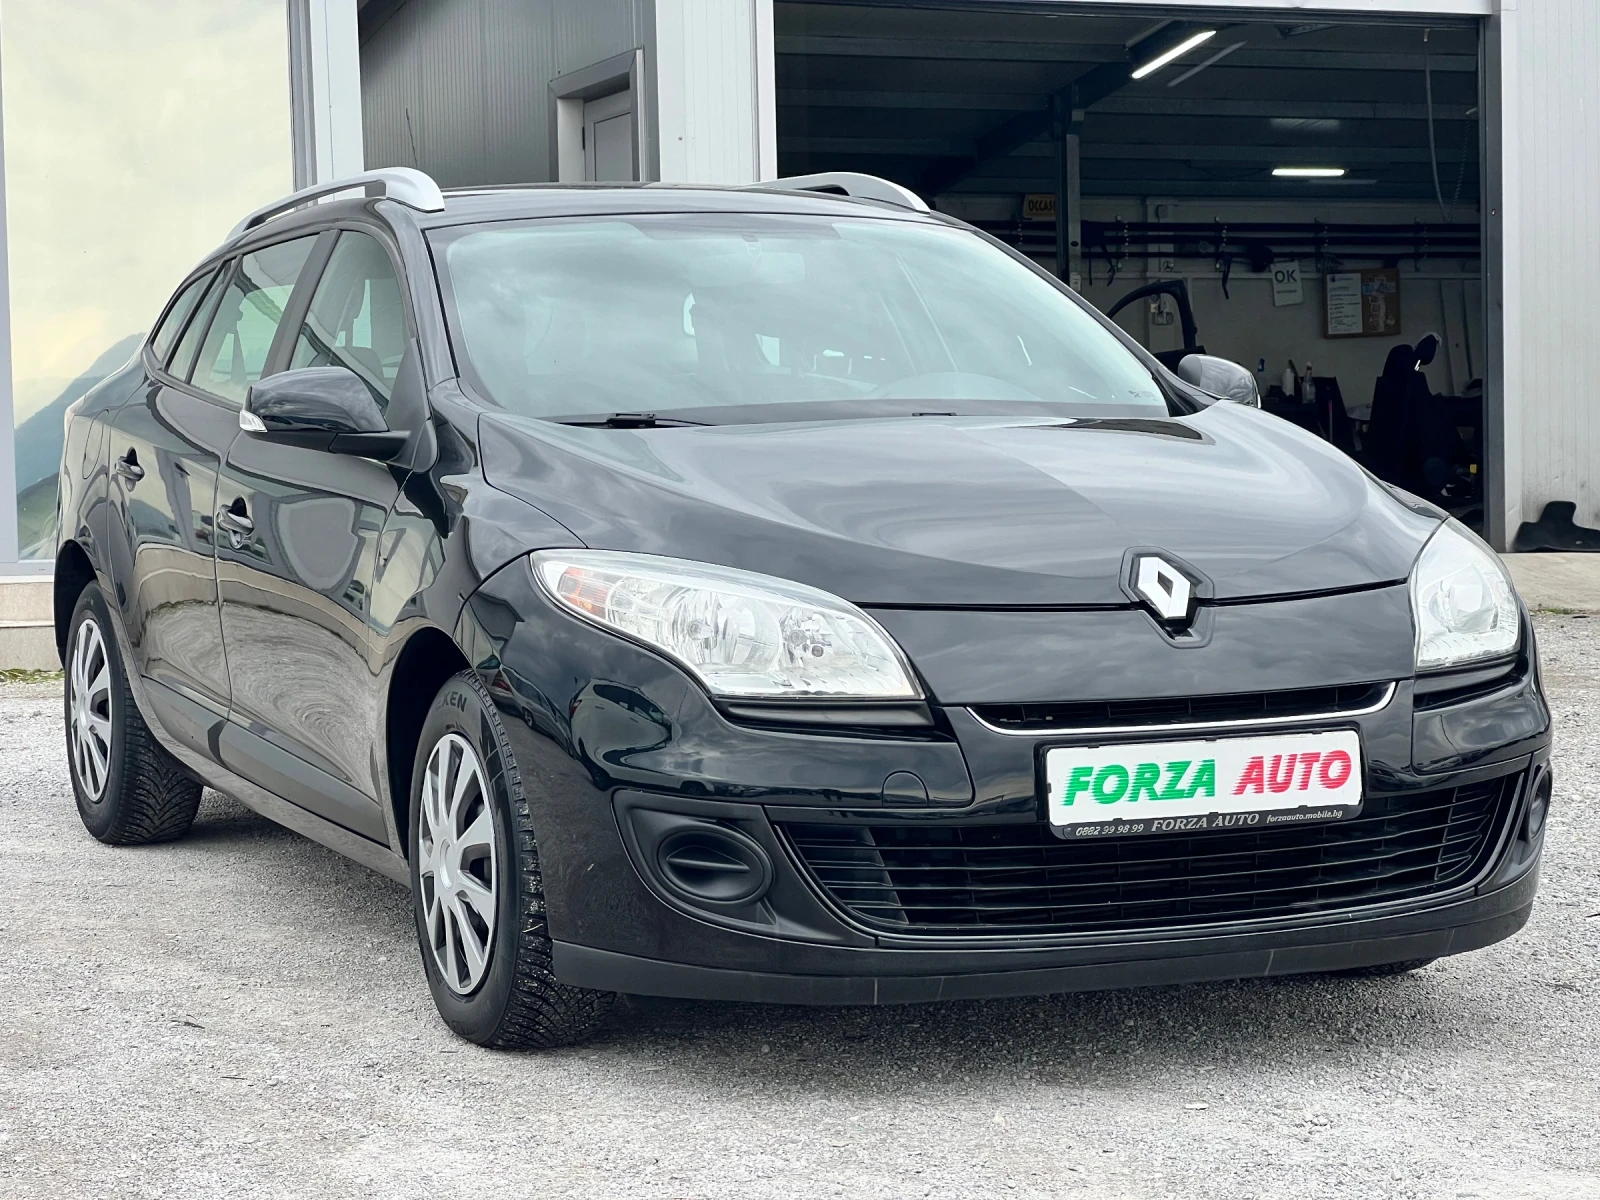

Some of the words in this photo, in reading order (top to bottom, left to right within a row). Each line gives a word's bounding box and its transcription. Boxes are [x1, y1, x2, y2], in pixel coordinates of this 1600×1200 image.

[1274, 269, 1297, 283] OK
[439, 690, 467, 713] KEN
[1059, 758, 1216, 806] FORZA
[1229, 749, 1352, 795] AUTO
[1075, 826, 1100, 836] 0882
[1101, 825, 1115, 835] 99
[1116, 824, 1130, 834] 98
[1131, 823, 1144, 833] 99
[1151, 817, 1208, 832] FORZA
[1212, 813, 1259, 827] AUTO
[1266, 810, 1343, 824] forzaauto.mobile.bg
